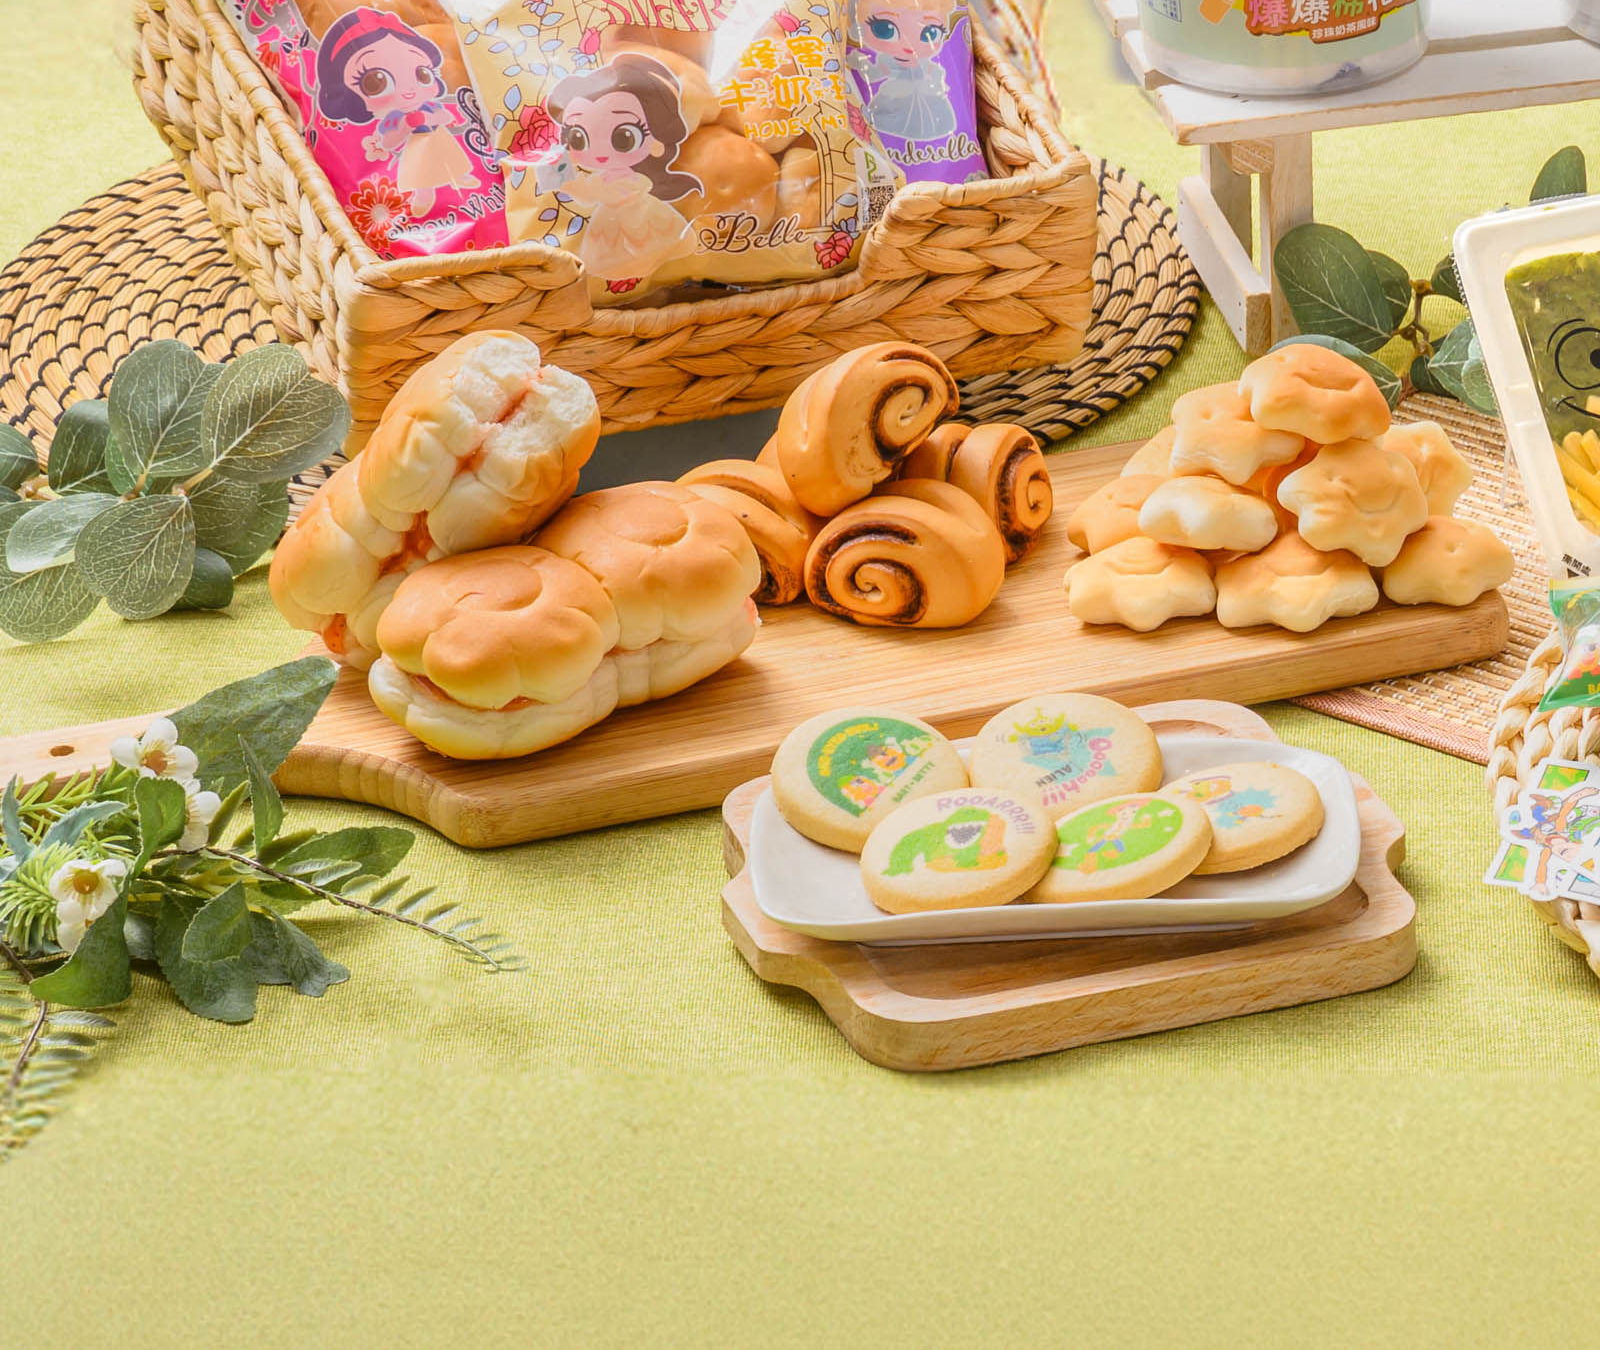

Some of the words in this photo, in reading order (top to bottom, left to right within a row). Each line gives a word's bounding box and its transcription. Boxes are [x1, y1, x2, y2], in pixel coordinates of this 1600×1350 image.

[1312, 16, 1377, 40] 珍珠奶茶風味
[739, 36, 827, 69] 蜂蜜
[744, 115, 813, 139] HONEY
[886, 130, 980, 164] nderella
[388, 214, 456, 241] Snow
[698, 211, 811, 253] Belle
[1036, 762, 1073, 787] ALIEN
